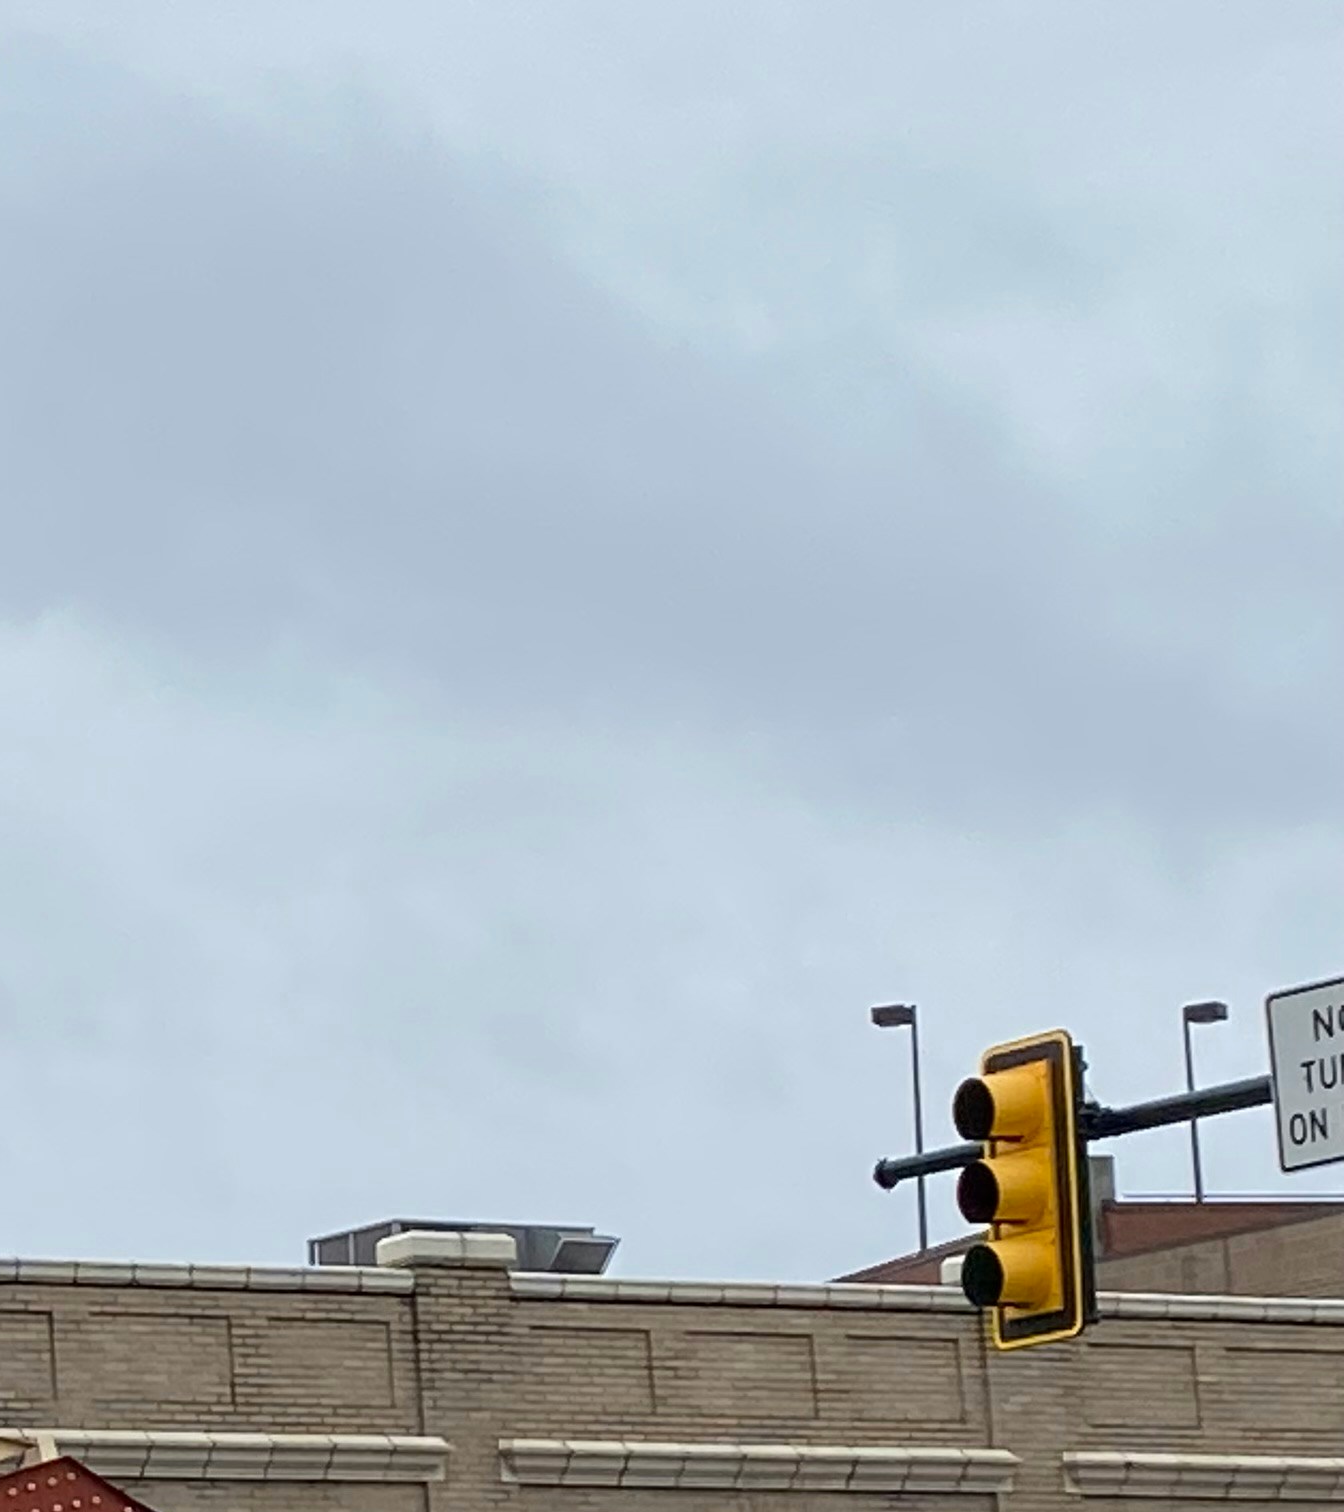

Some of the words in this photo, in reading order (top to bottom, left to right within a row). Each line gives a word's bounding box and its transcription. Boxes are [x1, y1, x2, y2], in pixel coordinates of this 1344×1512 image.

[1313, 1004, 1344, 1042] N
[1300, 1053, 1344, 1093] TU
[1290, 1107, 1328, 1145] ON
